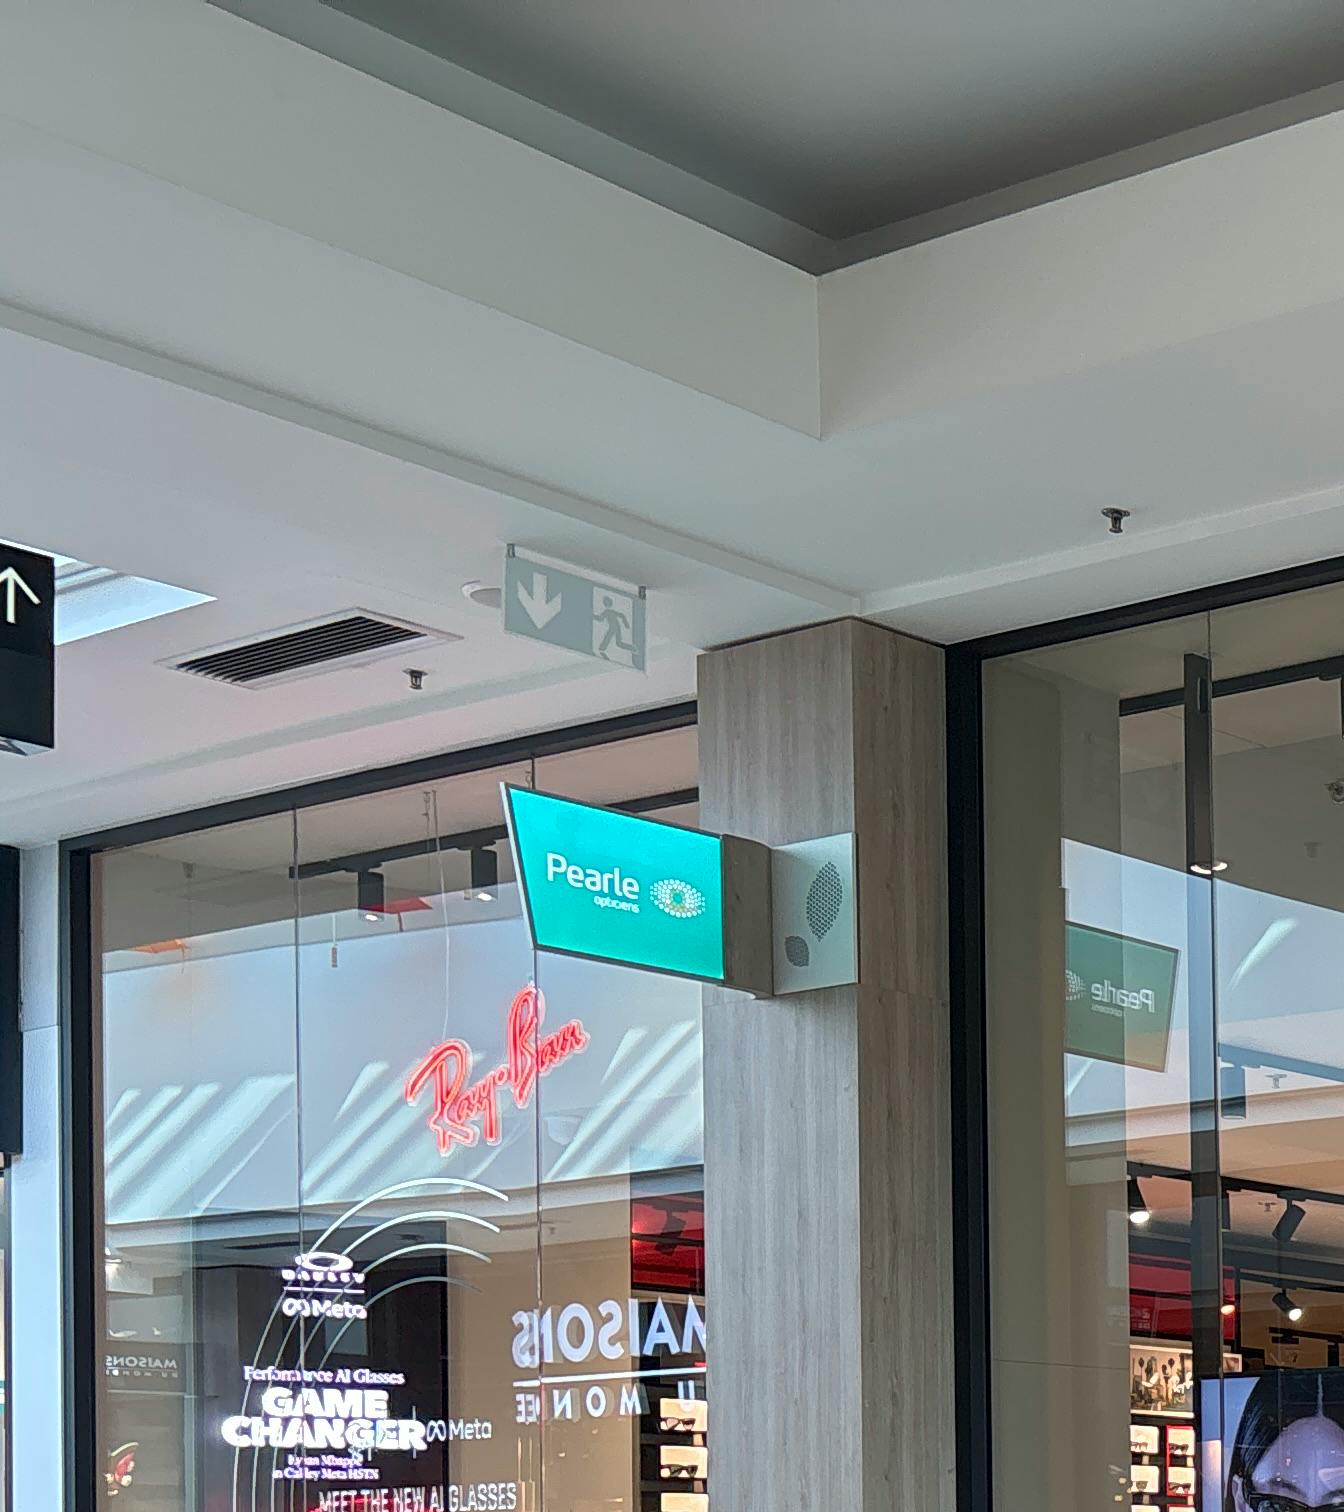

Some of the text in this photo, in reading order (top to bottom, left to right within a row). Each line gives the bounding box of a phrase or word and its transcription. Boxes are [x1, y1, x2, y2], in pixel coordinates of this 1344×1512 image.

[546, 851, 640, 900] Pearle
[312, 1299, 367, 1319] Meta
[262, 1386, 389, 1418] GAME
[221, 1415, 428, 1451] CHANGER
[448, 1418, 493, 1441] Meta
[448, 1482, 517, 1512] GLASSES
